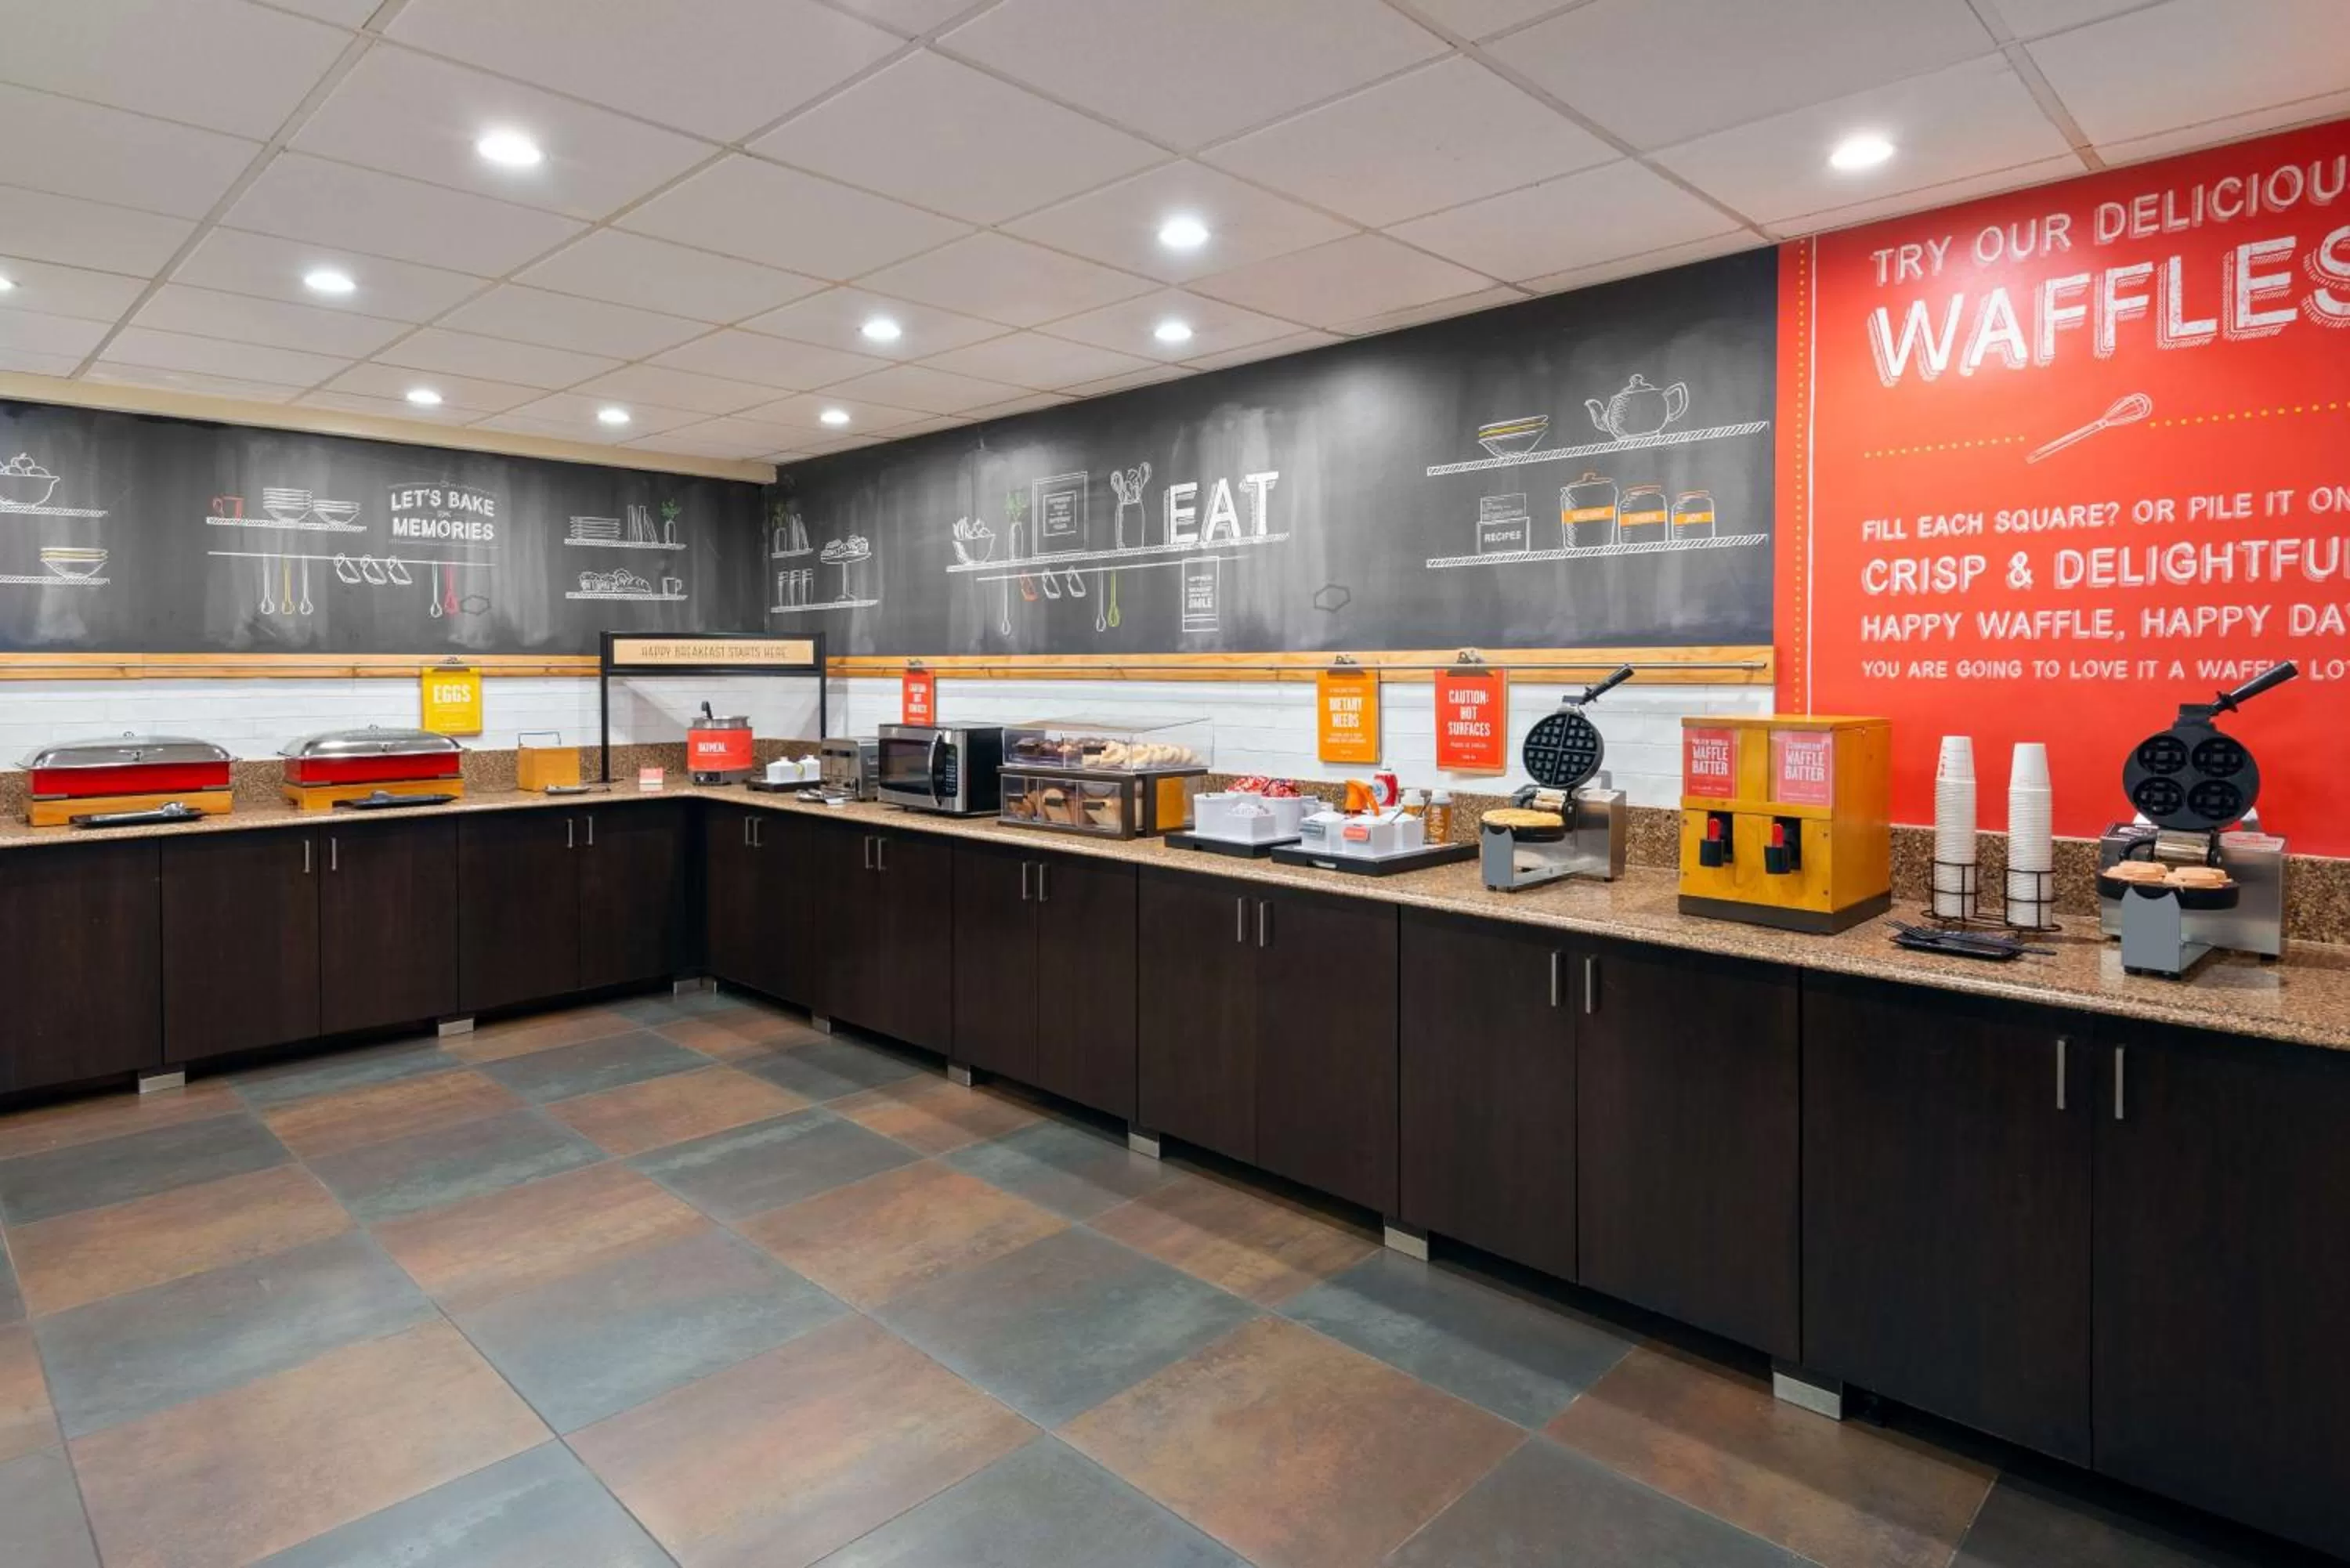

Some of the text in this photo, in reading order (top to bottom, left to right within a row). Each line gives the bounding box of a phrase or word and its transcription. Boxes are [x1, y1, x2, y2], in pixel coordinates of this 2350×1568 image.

[1870, 154, 2350, 287] TRY OUR DELICIOU
[391, 489, 495, 517] LET'S BAKE
[1164, 471, 1278, 545] EAT
[1862, 518, 1907, 542] FILL
[1917, 511, 1983, 538] EACH
[1994, 501, 2120, 533] SQUARE?
[2131, 499, 2175, 525] OR
[2188, 493, 2253, 521] PILE
[2266, 490, 2294, 515] IT
[392, 517, 495, 540] MEMORIES
[1484, 530, 1522, 543] RECIPES
[1861, 537, 2350, 596] CRISP & DELIGHTFU
[1861, 602, 2350, 644] HAPPY WAFFLE, HAPPY DA
[641, 645, 671, 659] HAPPY
[1861, 659, 2350, 681] YOU ARE GOING TO LOVE IT A WAFF LO
[433, 684, 472, 703] EGGS
[1460, 706, 1477, 720] HOT
[1448, 721, 1491, 737] SURFACES
[1693, 745, 1730, 761] WAFFLE
[1785, 751, 1824, 766] WAFFLE
[1692, 760, 1729, 775] BATTER
[1785, 765, 1824, 781] BATTER
